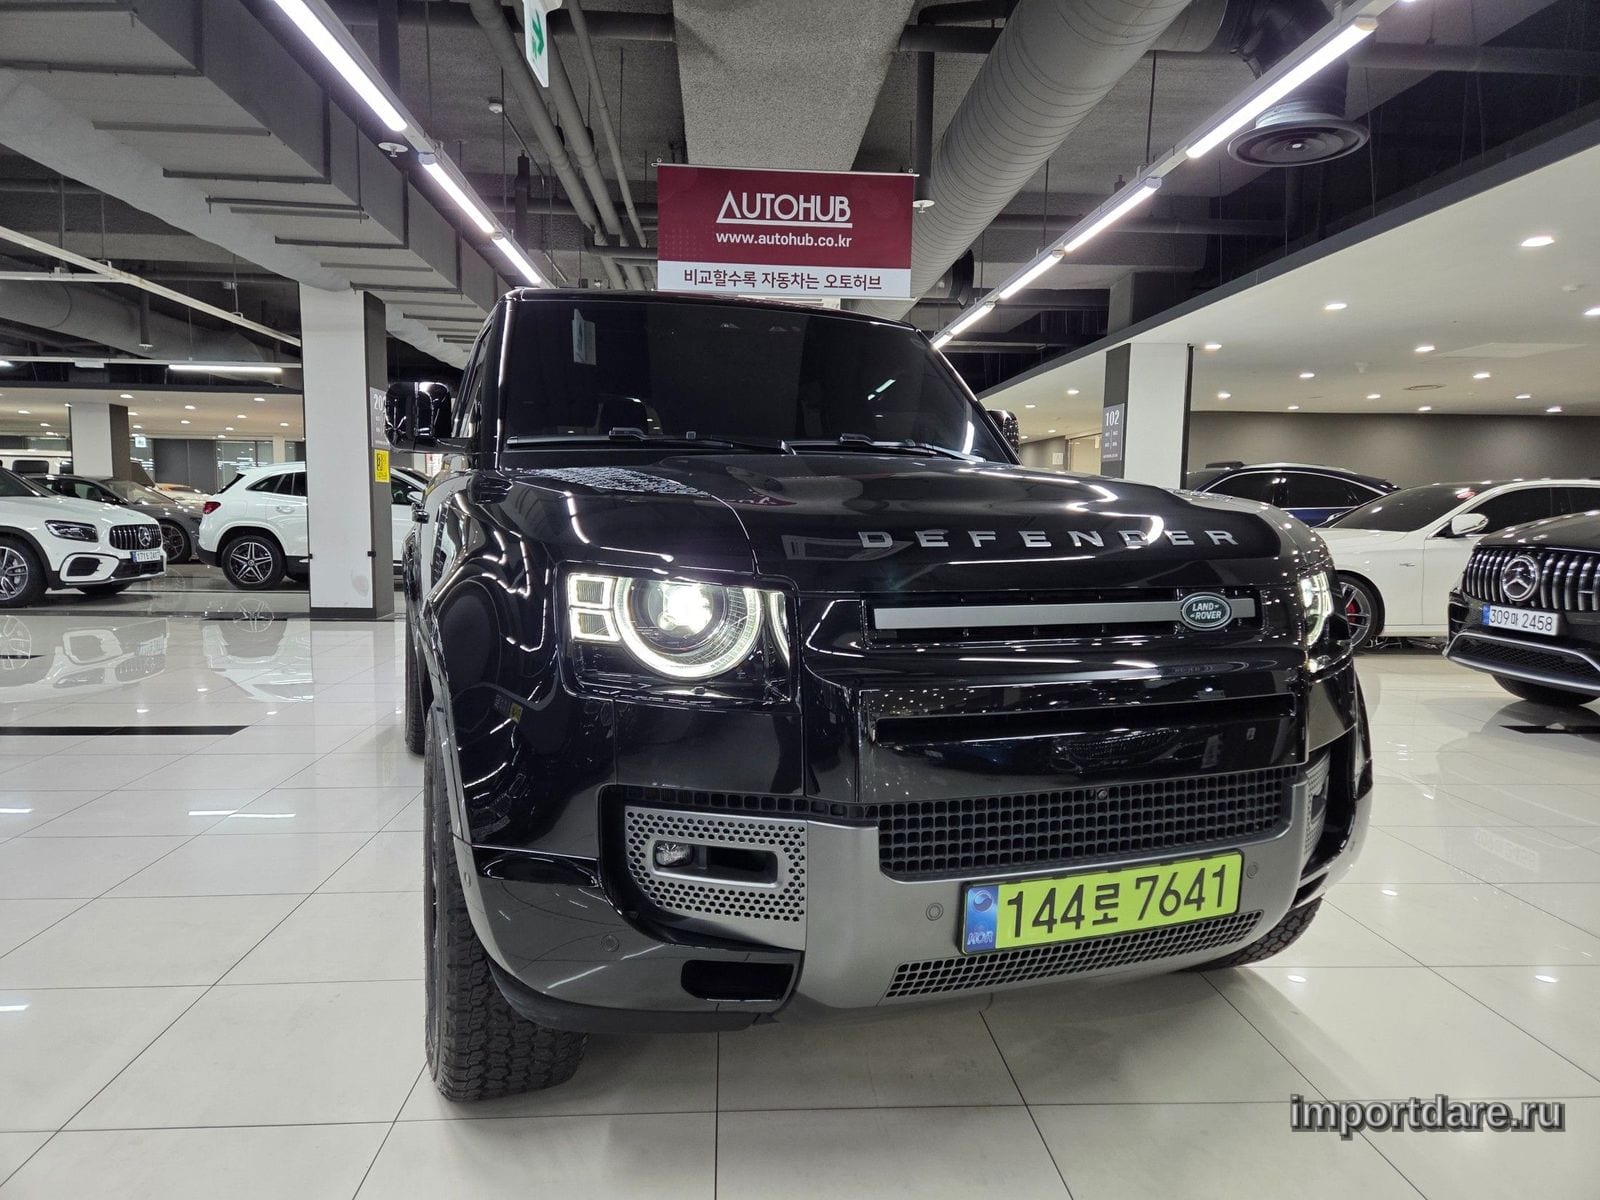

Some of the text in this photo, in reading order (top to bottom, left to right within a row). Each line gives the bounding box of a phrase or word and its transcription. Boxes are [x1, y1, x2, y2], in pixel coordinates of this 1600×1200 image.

[716, 190, 852, 226] AUTOHUB
[715, 232, 852, 248] www.autohub.co.kr
[684, 269, 882, 292] 비교할수록 자동차는 오토허브
[1106, 409, 1120, 427] 102
[858, 530, 1239, 549] DEFENDER
[1192, 602, 1214, 612] LAND
[1195, 610, 1222, 620] ROVER
[1522, 613, 1553, 632] 2458
[1007, 863, 1227, 938] 144로 7641
